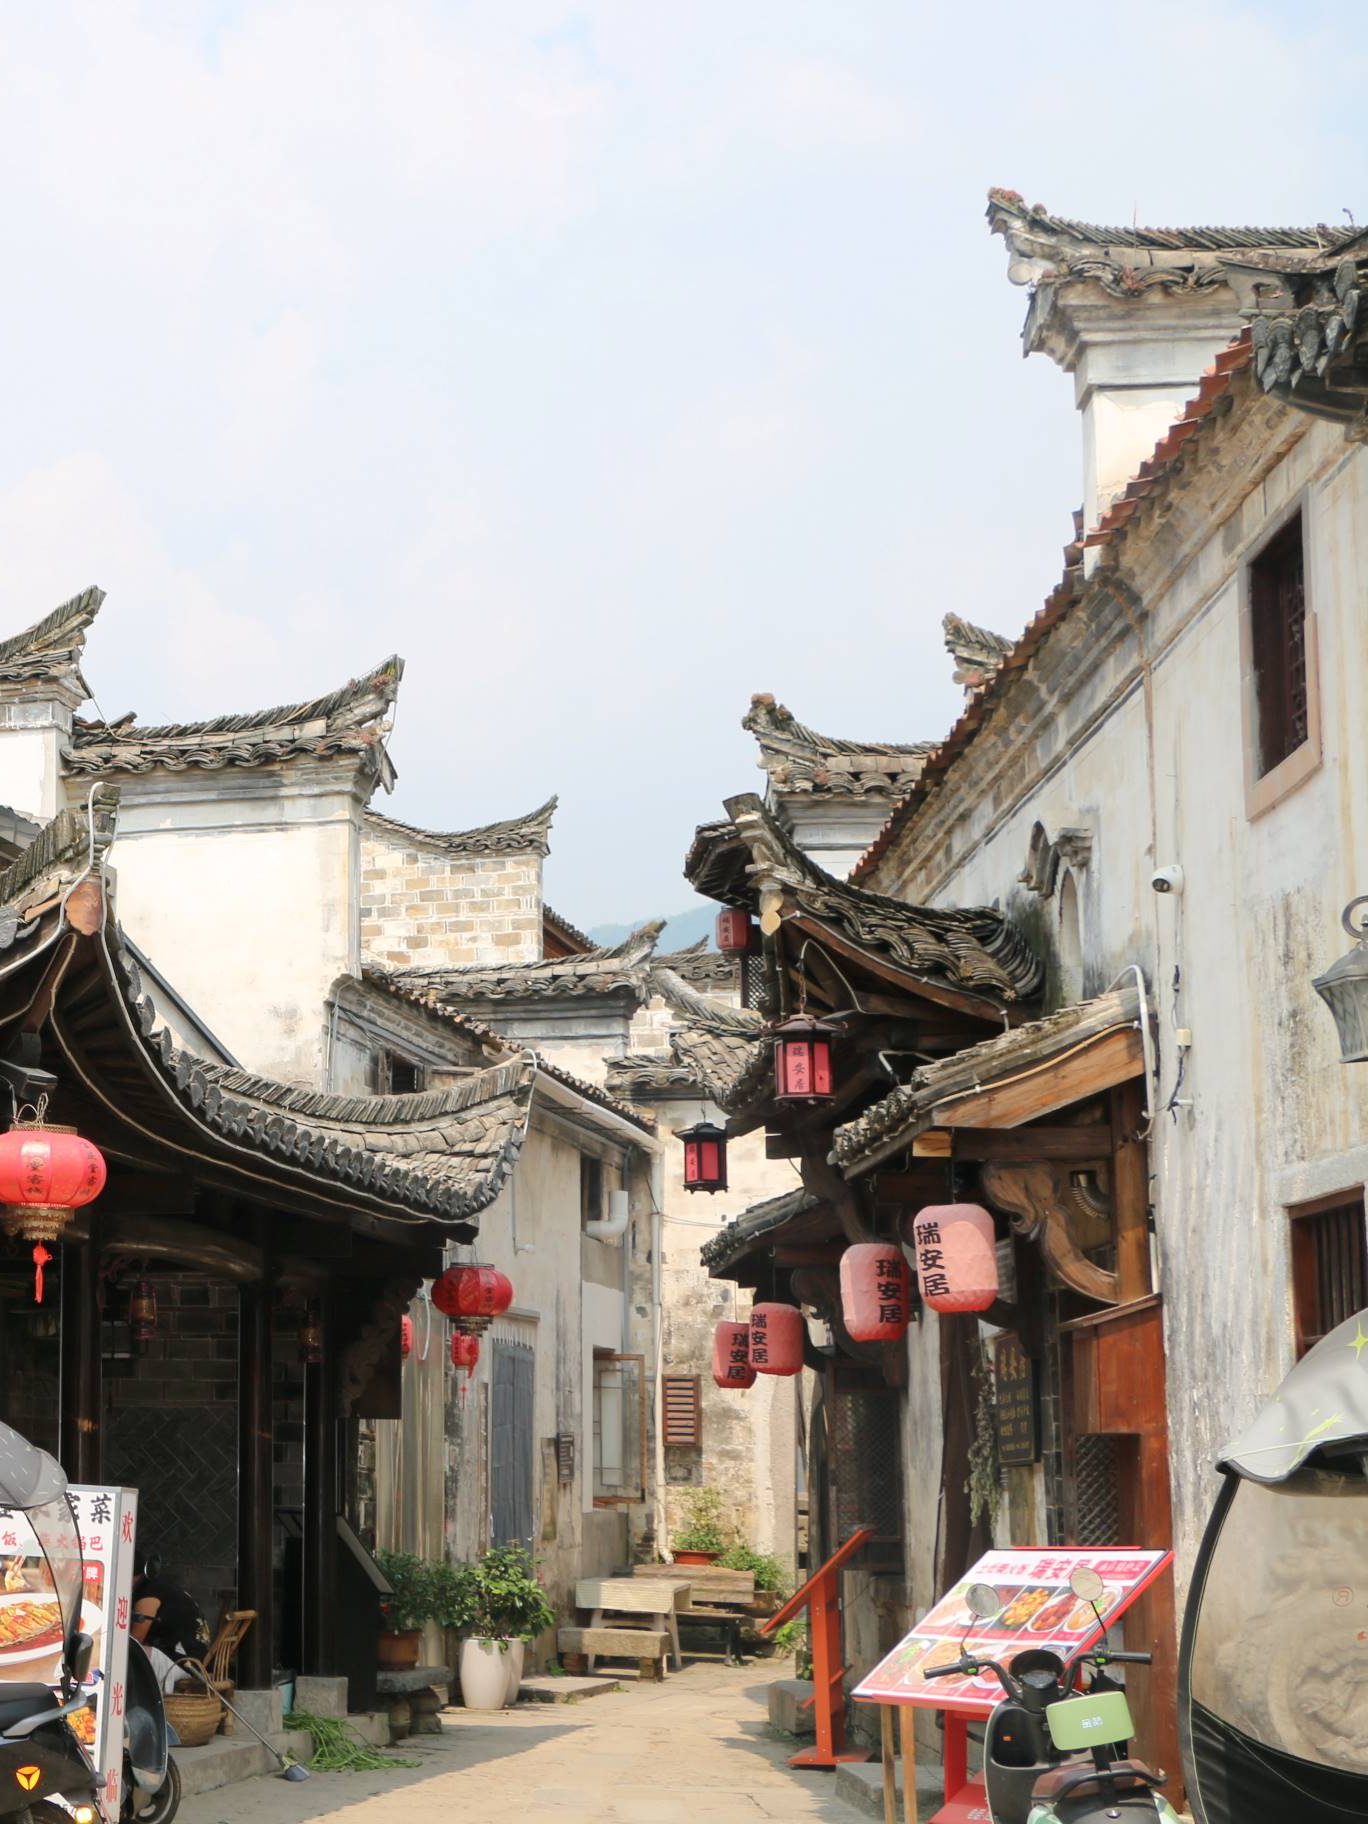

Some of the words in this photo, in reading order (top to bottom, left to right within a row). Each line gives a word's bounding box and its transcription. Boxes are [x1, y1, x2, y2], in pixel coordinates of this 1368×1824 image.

[875, 1258, 903, 1324] 瑞安居
[915, 1221, 950, 1297] 瑞安居
[727, 1332, 748, 1381] 瑞安居
[751, 1313, 768, 1364] 瑞安居
[104, 1511, 134, 1805] 欢迎光临
